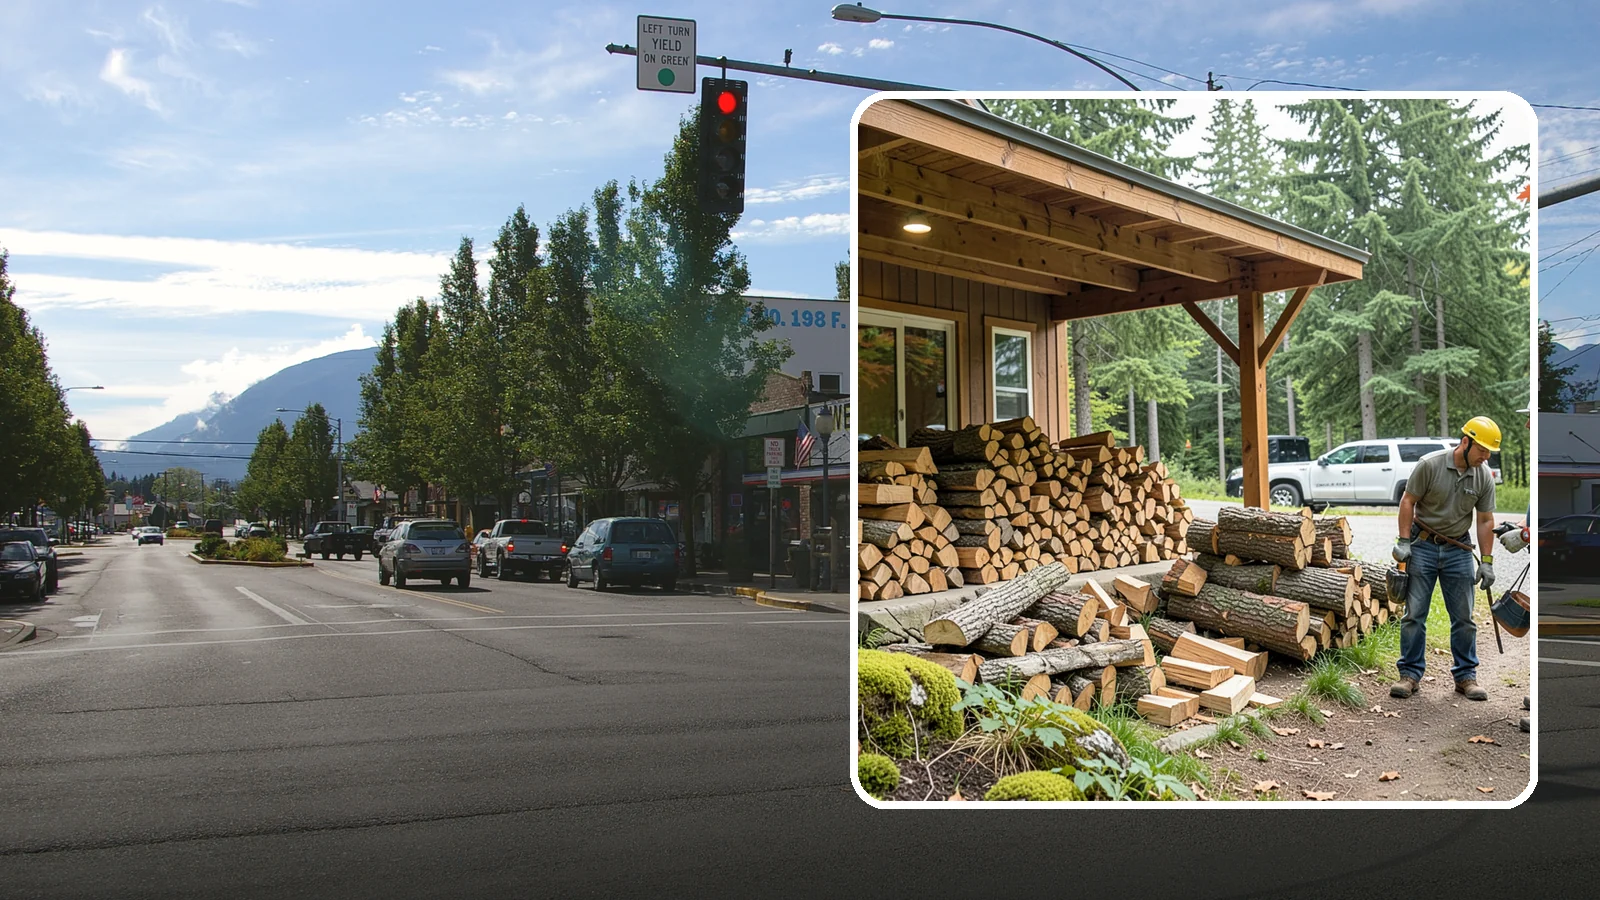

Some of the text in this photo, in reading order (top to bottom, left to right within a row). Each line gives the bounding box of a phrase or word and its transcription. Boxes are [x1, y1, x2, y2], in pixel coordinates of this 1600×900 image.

[643, 24, 690, 36] LEFT TURN
[652, 38, 682, 52] YIELD
[644, 54, 689, 66] ON GREEN
[792, 310, 826, 328] 198
[832, 312, 846, 328] F.
